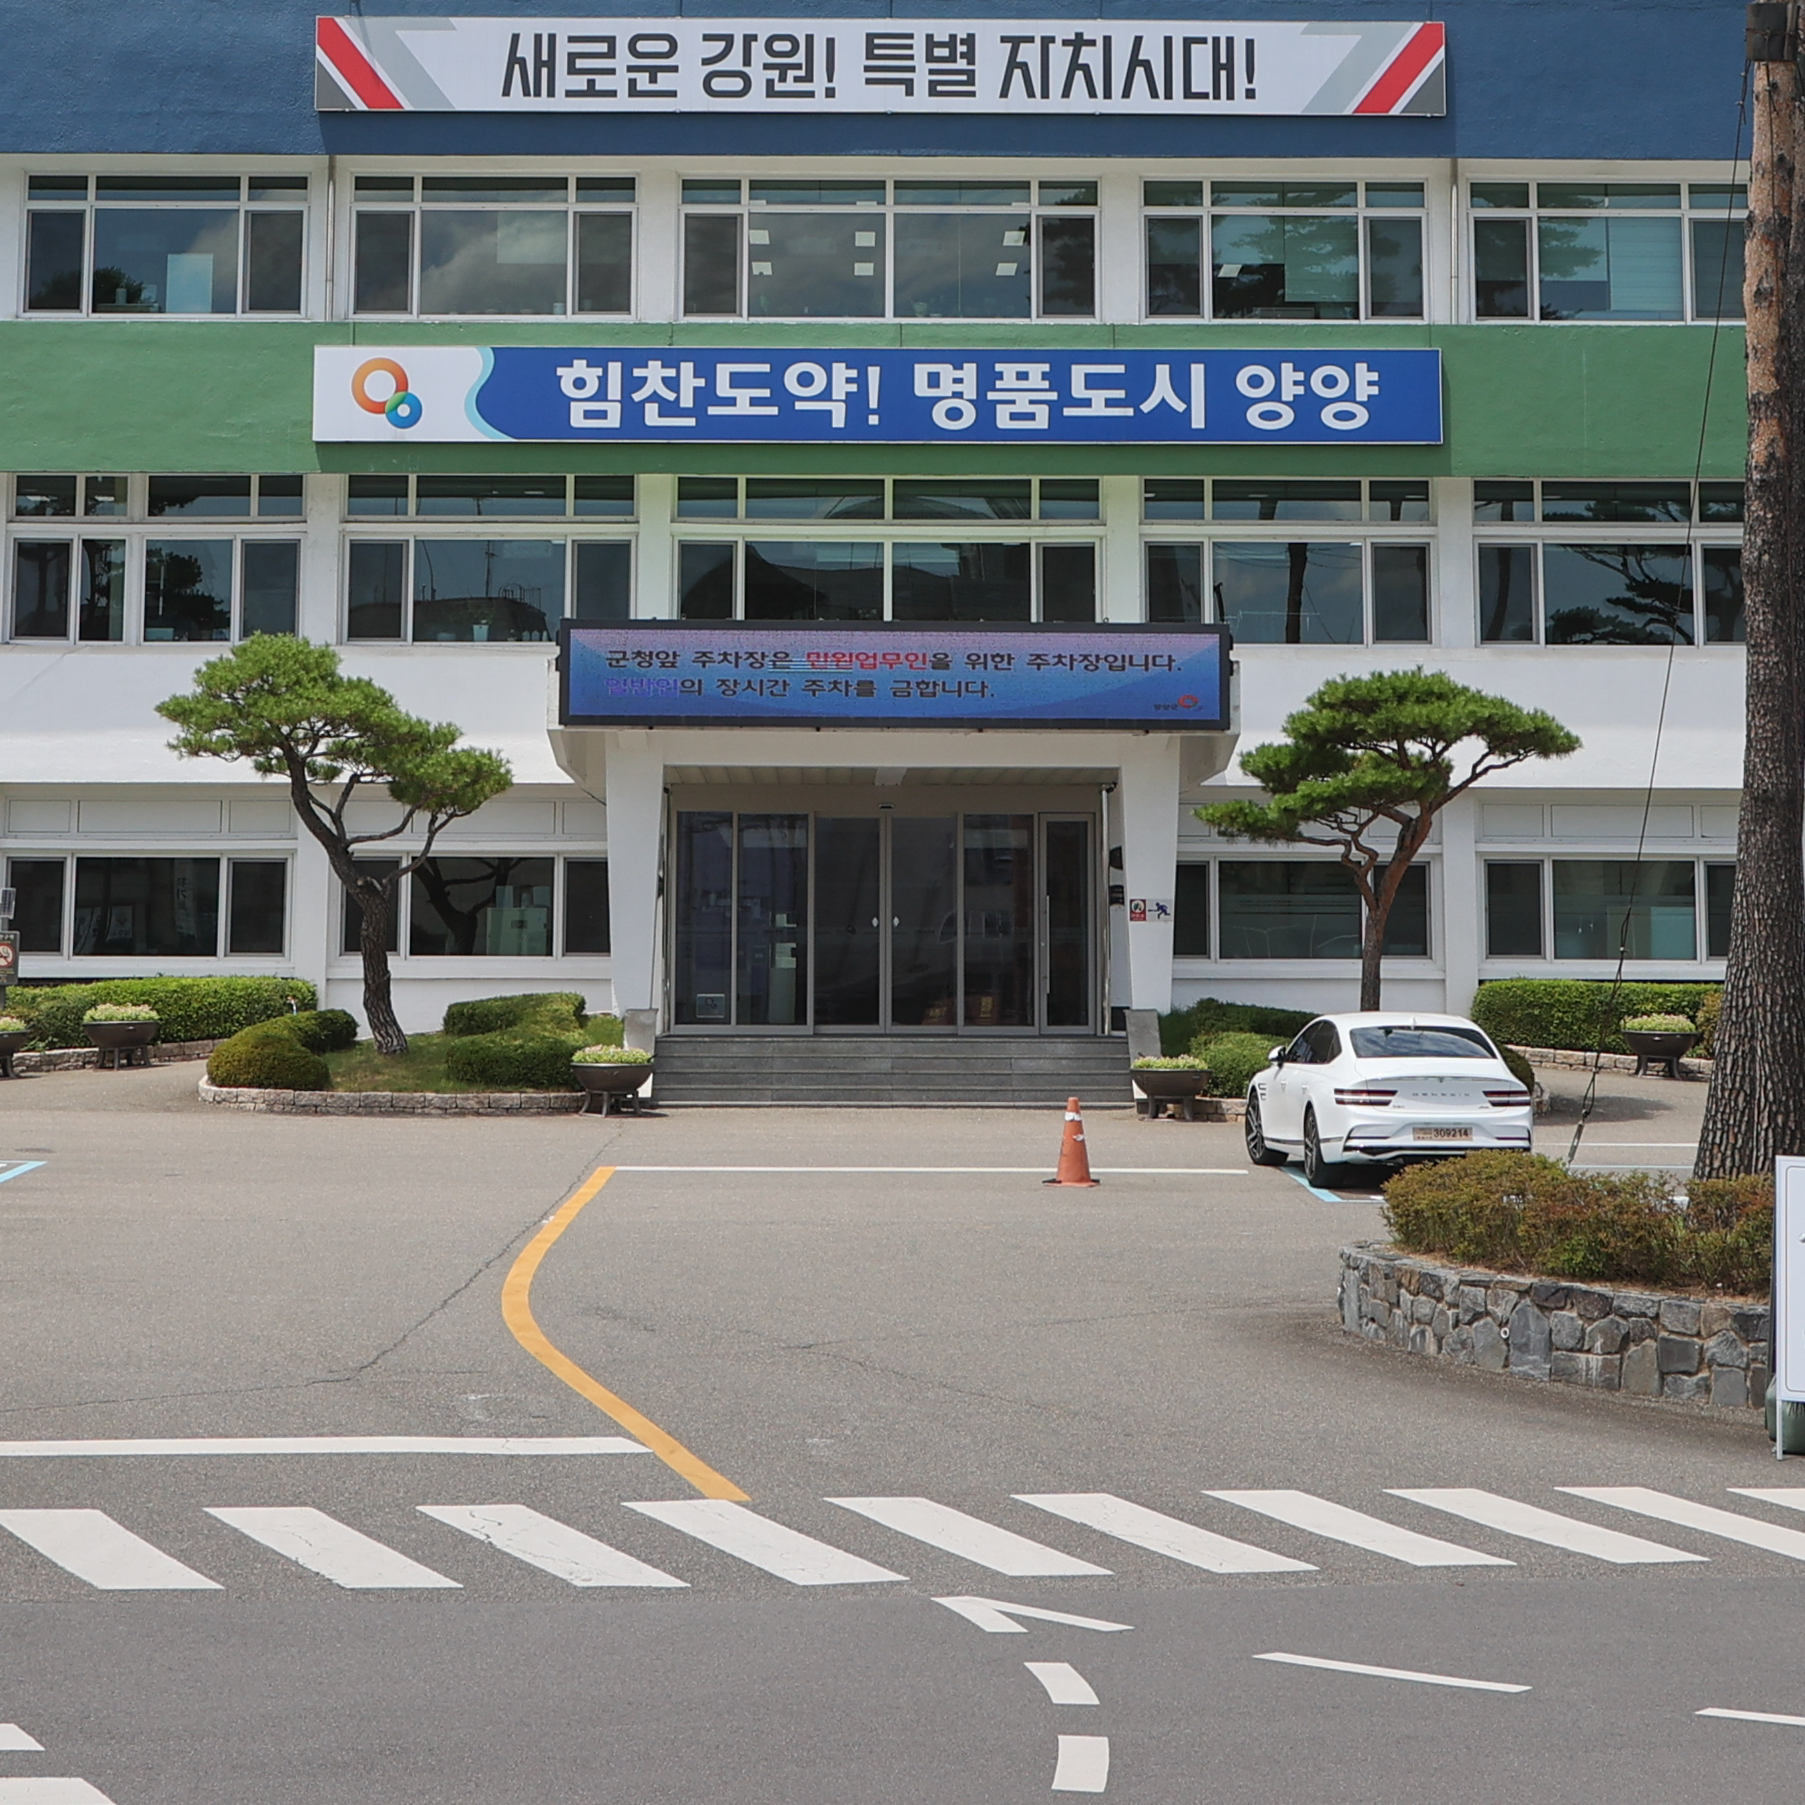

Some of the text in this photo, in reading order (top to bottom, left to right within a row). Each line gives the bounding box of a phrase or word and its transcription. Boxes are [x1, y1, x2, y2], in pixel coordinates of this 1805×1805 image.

[501, 31, 1258, 102] 새로운 강원! 특별 자치시대!
[556, 358, 1380, 431] 힘찬도약! 명품도시 양양
[605, 649, 681, 669] 군청앞
[692, 650, 793, 671] 주차장은
[964, 652, 1015, 672] 위한
[1026, 652, 1183, 673] 주차장입니다.
[715, 678, 791, 698] 장시간
[801, 678, 877, 698] 주차를
[889, 679, 995, 699] 금합니다.
[1433, 1128, 1469, 1138] 309214
